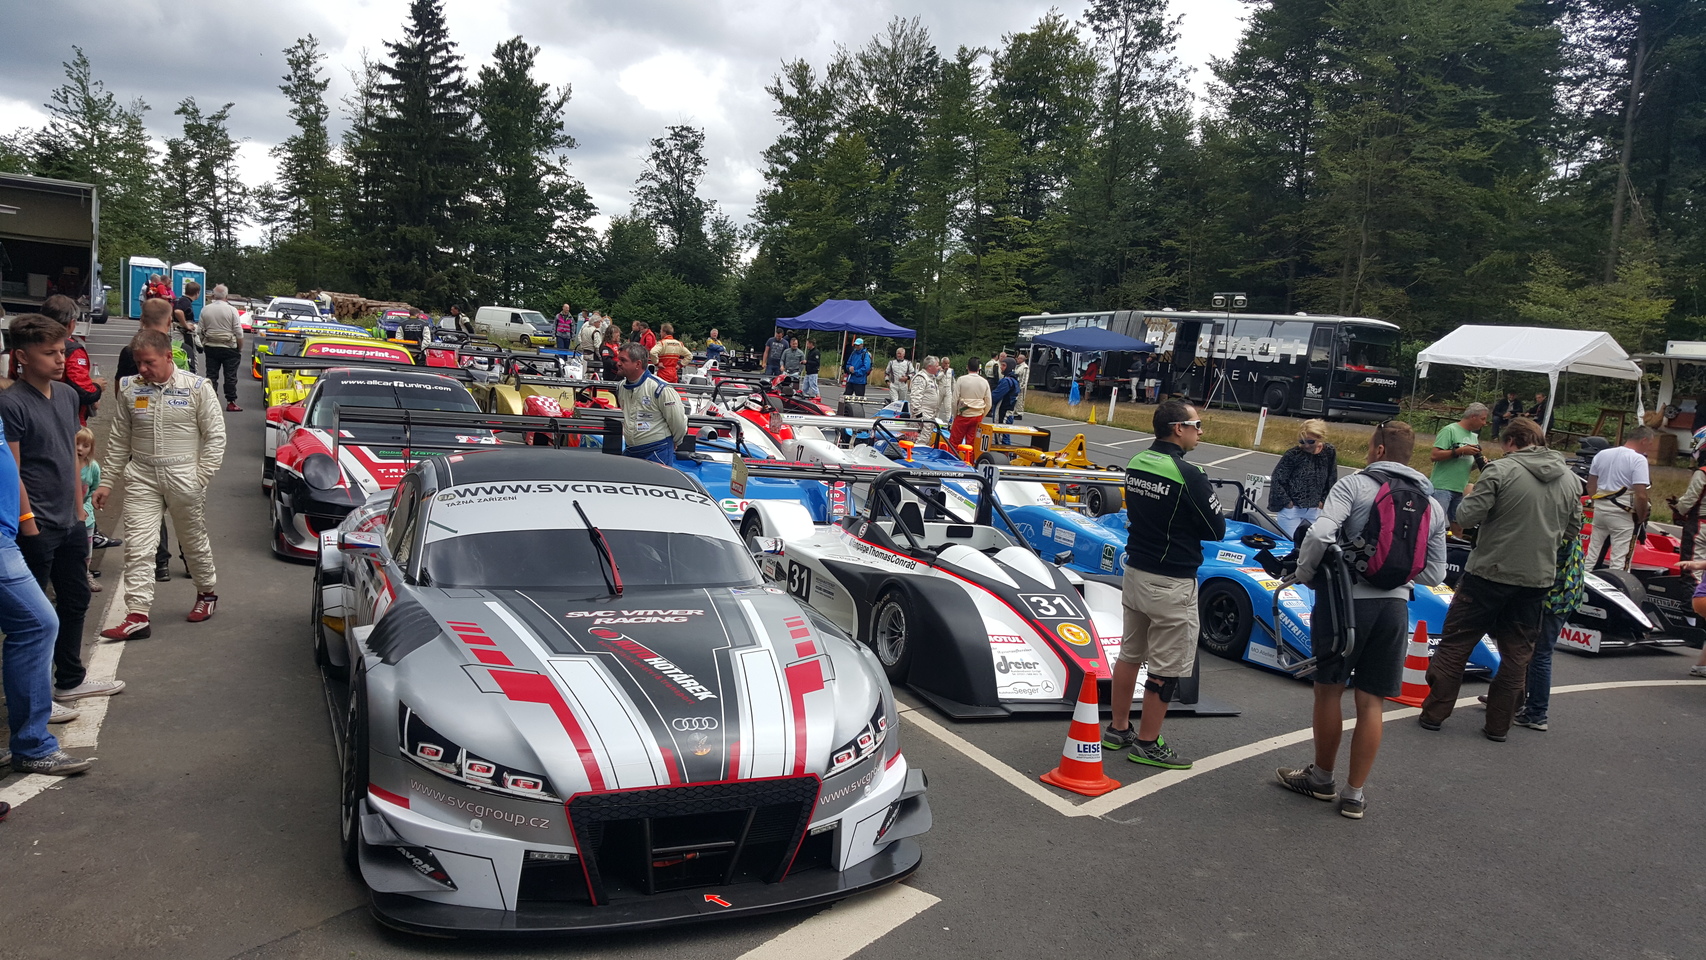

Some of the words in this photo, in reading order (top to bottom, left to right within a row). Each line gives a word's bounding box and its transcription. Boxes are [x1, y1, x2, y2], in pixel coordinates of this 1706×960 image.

[321, 347, 400, 359] Powersprint.eu
[981, 435, 990, 451] 10
[453, 483, 712, 506] www.svcnachod.cz
[1126, 474, 1170, 496] Kawasaki
[1127, 485, 1144, 496] Racing
[1144, 489, 1160, 500] Team
[1244, 487, 1257, 511] 11
[790, 564, 808, 598] 31
[566, 610, 616, 618] SVC
[1030, 596, 1076, 617] 31
[593, 616, 688, 625] RACING
[996, 655, 1039, 674] dreier
[1013, 687, 1039, 695] Seeger
[410, 778, 551, 829] www.svcgroup.cz
[396, 847, 435, 872] AVON
